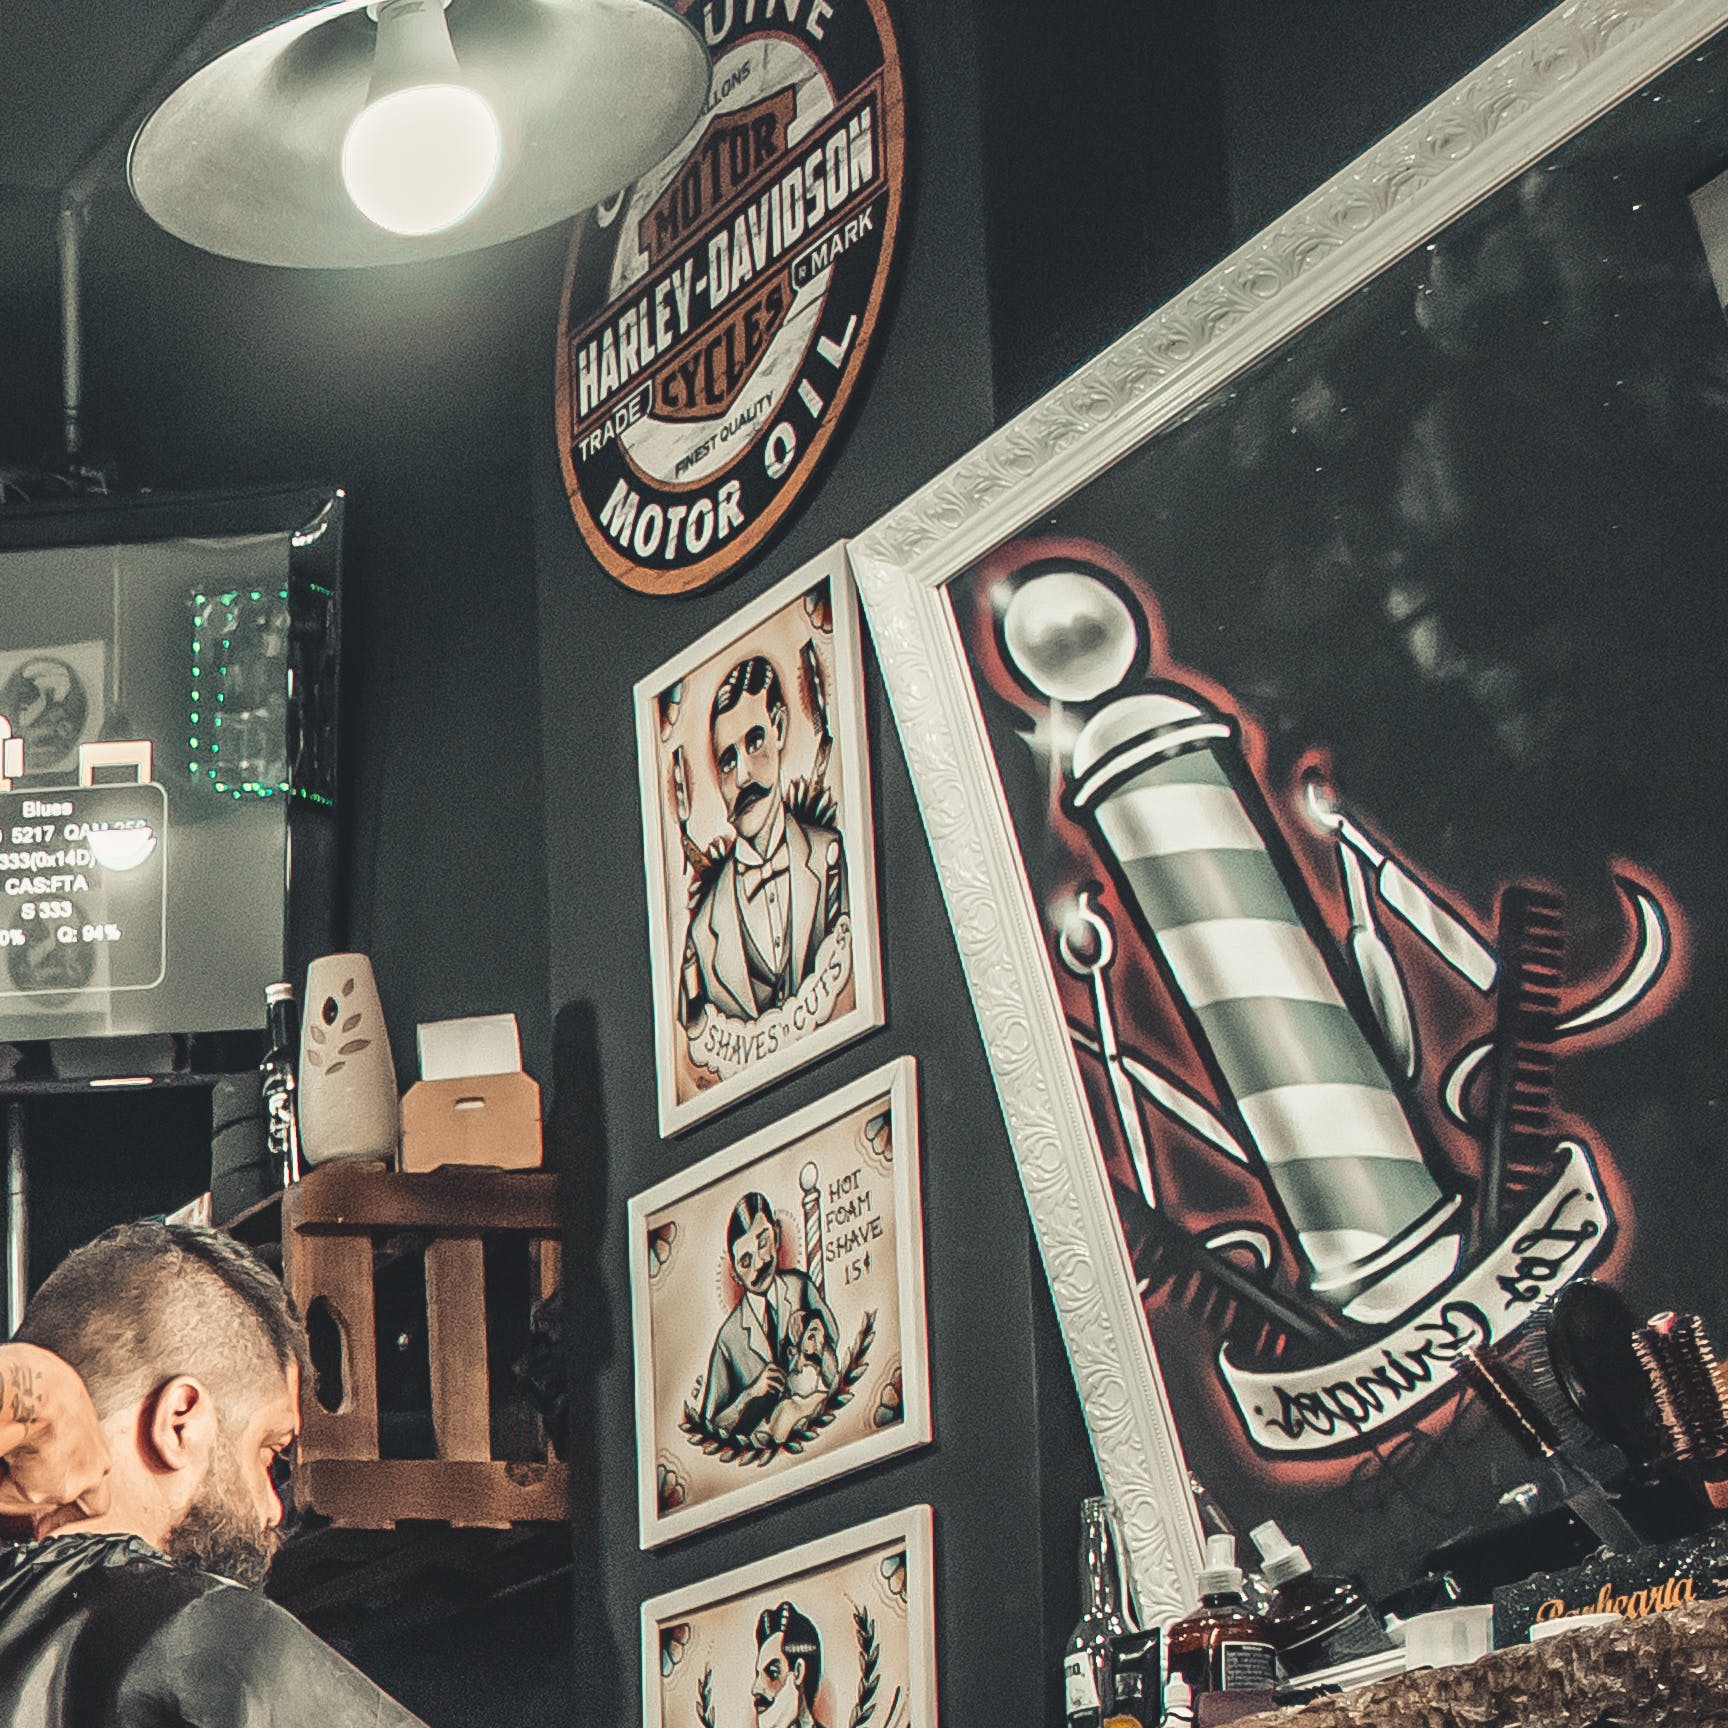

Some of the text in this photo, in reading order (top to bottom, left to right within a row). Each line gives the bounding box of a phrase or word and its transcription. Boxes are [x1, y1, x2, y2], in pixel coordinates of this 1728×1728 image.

[653, 111, 778, 249] MOTOR
[579, 106, 873, 417] HARLEY-DAVIDSON
[579, 206, 873, 462] TRADE MARK
[661, 279, 787, 409] CYCLES
[599, 314, 857, 559] MOTOR OIL
[675, 391, 775, 478] FINEST QUALITY
[11, 825, 56, 845] 5217
[22, 800, 73, 818] Blues
[21, 901, 73, 920] S 333
[705, 1024, 780, 1066] SHAVES
[794, 951, 842, 1031] CUTS
[825, 1190, 871, 1233] FOAM
[828, 1169, 861, 1203] HOT
[825, 1216, 883, 1262] SHAVE
